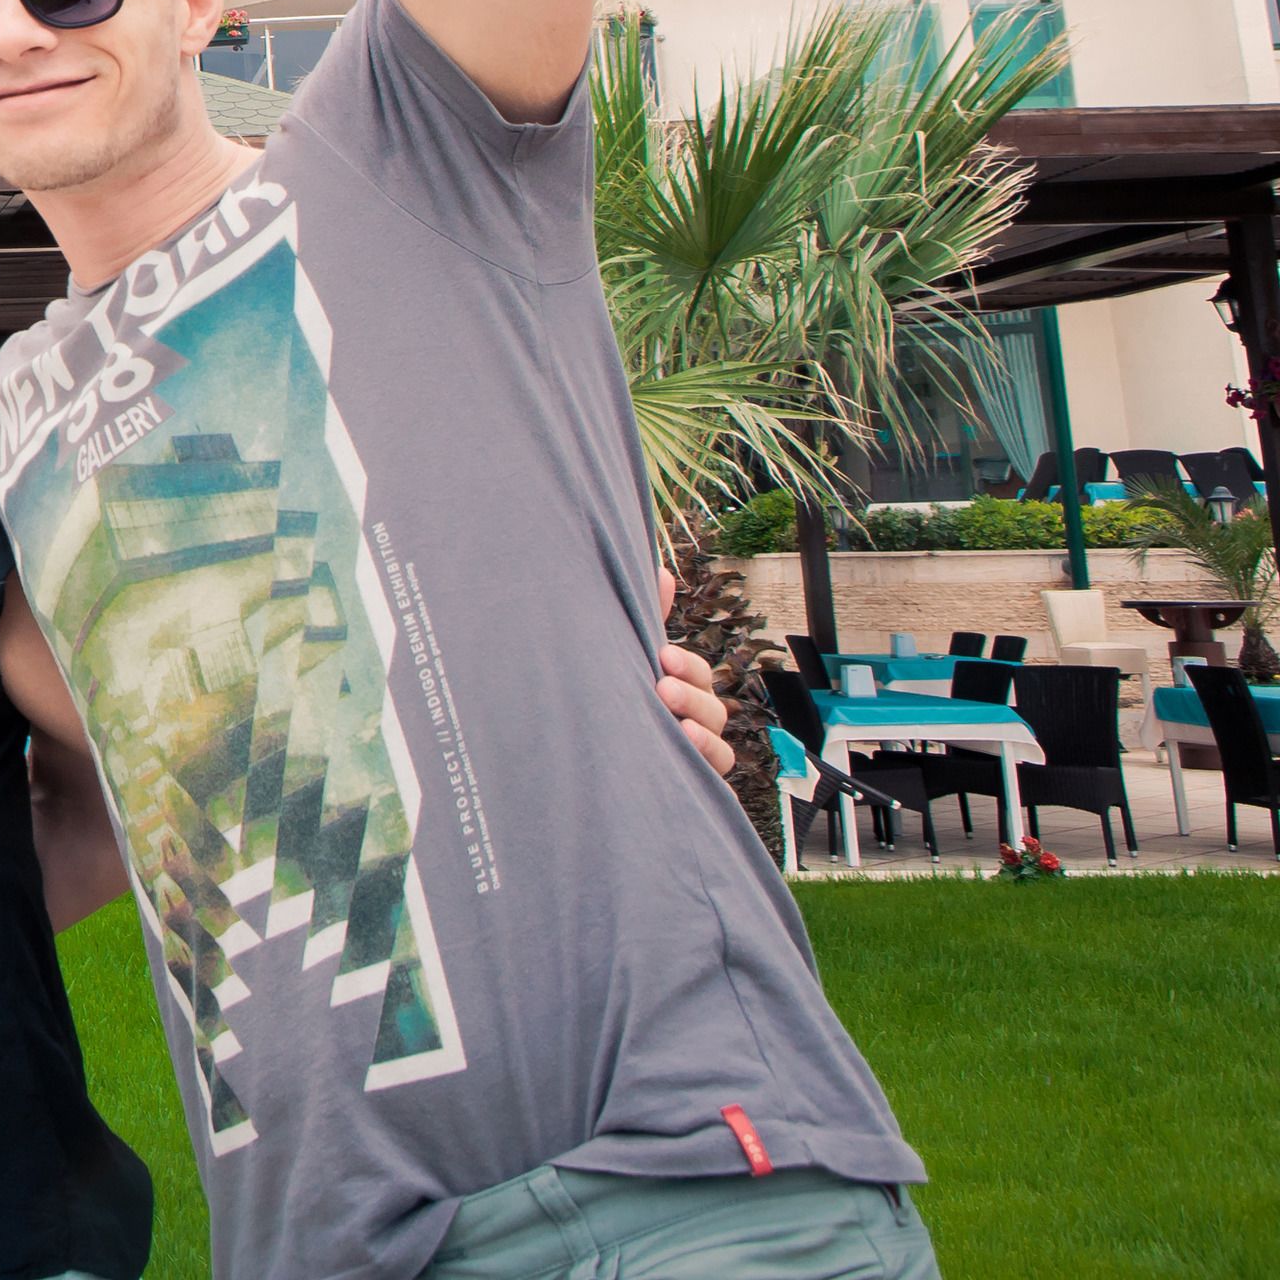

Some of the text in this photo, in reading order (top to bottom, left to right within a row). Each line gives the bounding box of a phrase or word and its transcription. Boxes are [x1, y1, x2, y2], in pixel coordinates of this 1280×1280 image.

[67, 342, 155, 444] 58
[76, 396, 163, 483] GALLERY
[371, 520, 410, 609] EXHIBITION
[400, 612, 428, 664] DENIM
[417, 667, 445, 725] INDIGO
[442, 748, 474, 835] PROJECT
[471, 794, 481, 809] for
[466, 841, 489, 894] BLUE
